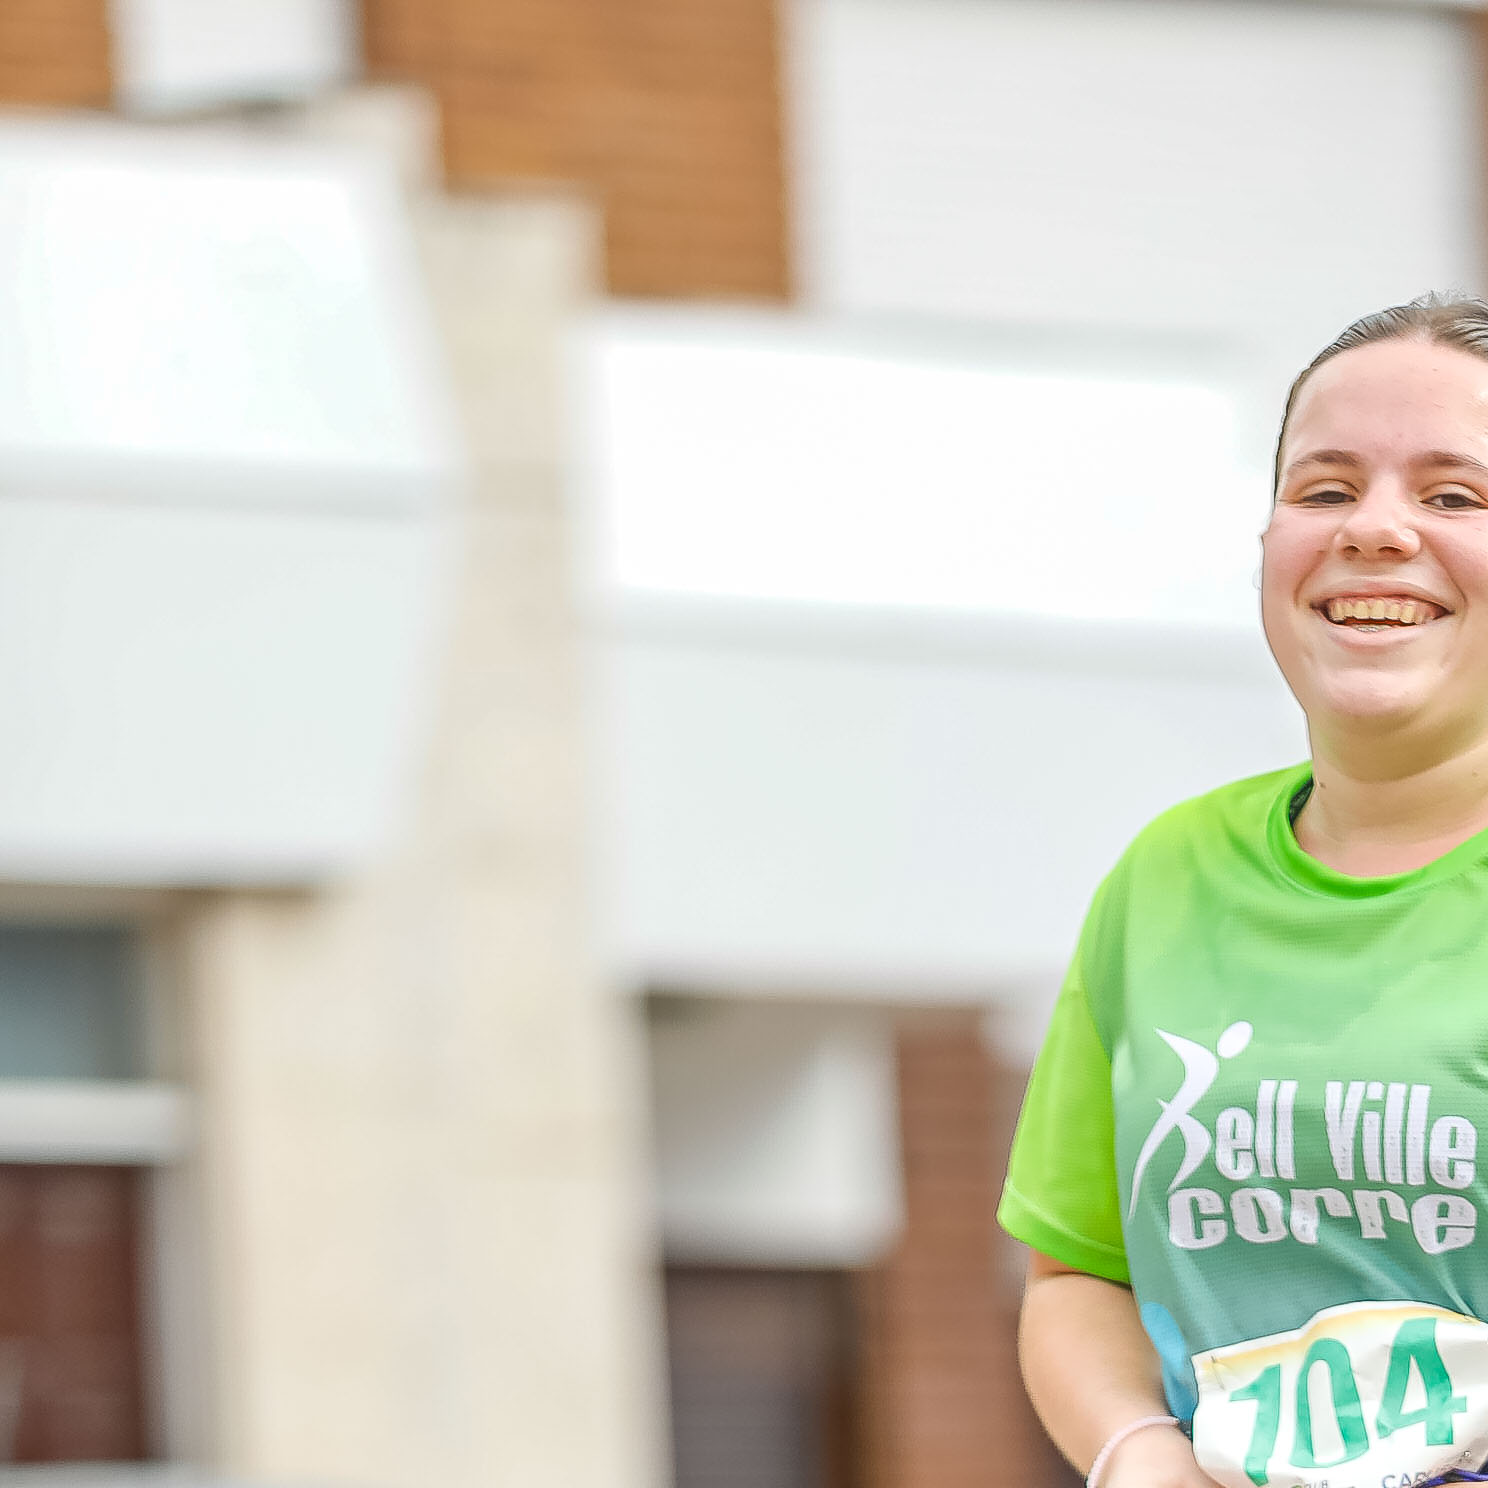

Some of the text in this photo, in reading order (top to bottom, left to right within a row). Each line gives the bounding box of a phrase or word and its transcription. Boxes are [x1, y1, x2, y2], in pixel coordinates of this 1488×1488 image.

[1325, 1081, 1477, 1190] Ville
[1168, 1187, 1477, 1255] corre
[1229, 1316, 1467, 1487] 104
